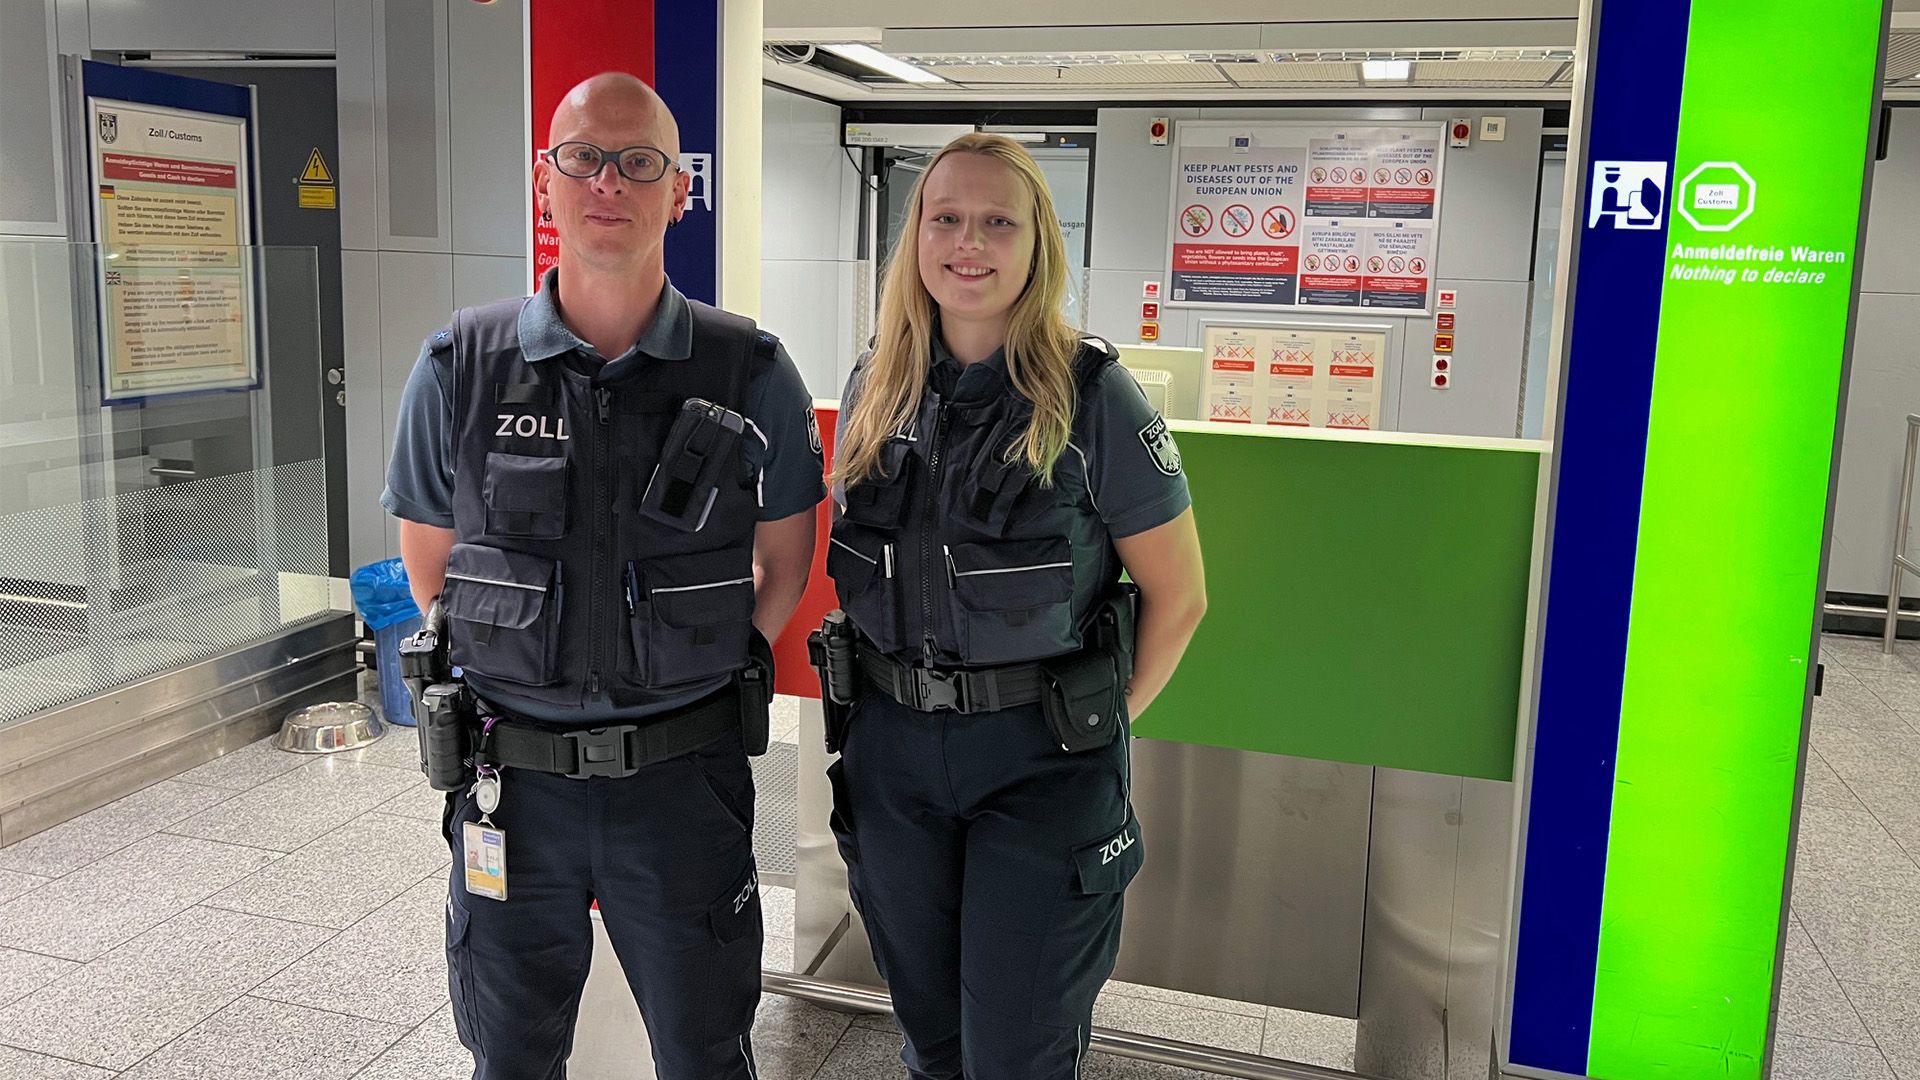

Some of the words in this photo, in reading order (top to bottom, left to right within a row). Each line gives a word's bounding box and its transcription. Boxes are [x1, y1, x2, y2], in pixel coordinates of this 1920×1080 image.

[1184, 164, 1208, 172] KEEP
[1210, 164, 1241, 173] PLANT
[1244, 165, 1274, 173] PESTS
[1277, 165, 1298, 173] AND
[1187, 175, 1233, 184] DISEASES
[1236, 176, 1256, 184] OUT
[1259, 176, 1272, 184] OF
[1275, 176, 1294, 184] THE
[1196, 187, 1247, 195] EUROPEAN
[1250, 187, 1282, 195] UNION
[1671, 243, 1784, 262] Anmeldefreie
[1790, 246, 1845, 263] Waren
[1670, 264, 1737, 285] Nothing
[1741, 267, 1758, 282] to
[1763, 267, 1825, 284] declare
[495, 414, 570, 440] ZOLL
[1146, 419, 1165, 440] ZOLL
[1099, 829, 1136, 866] ZOLL
[733, 870, 757, 915] ZOLL
